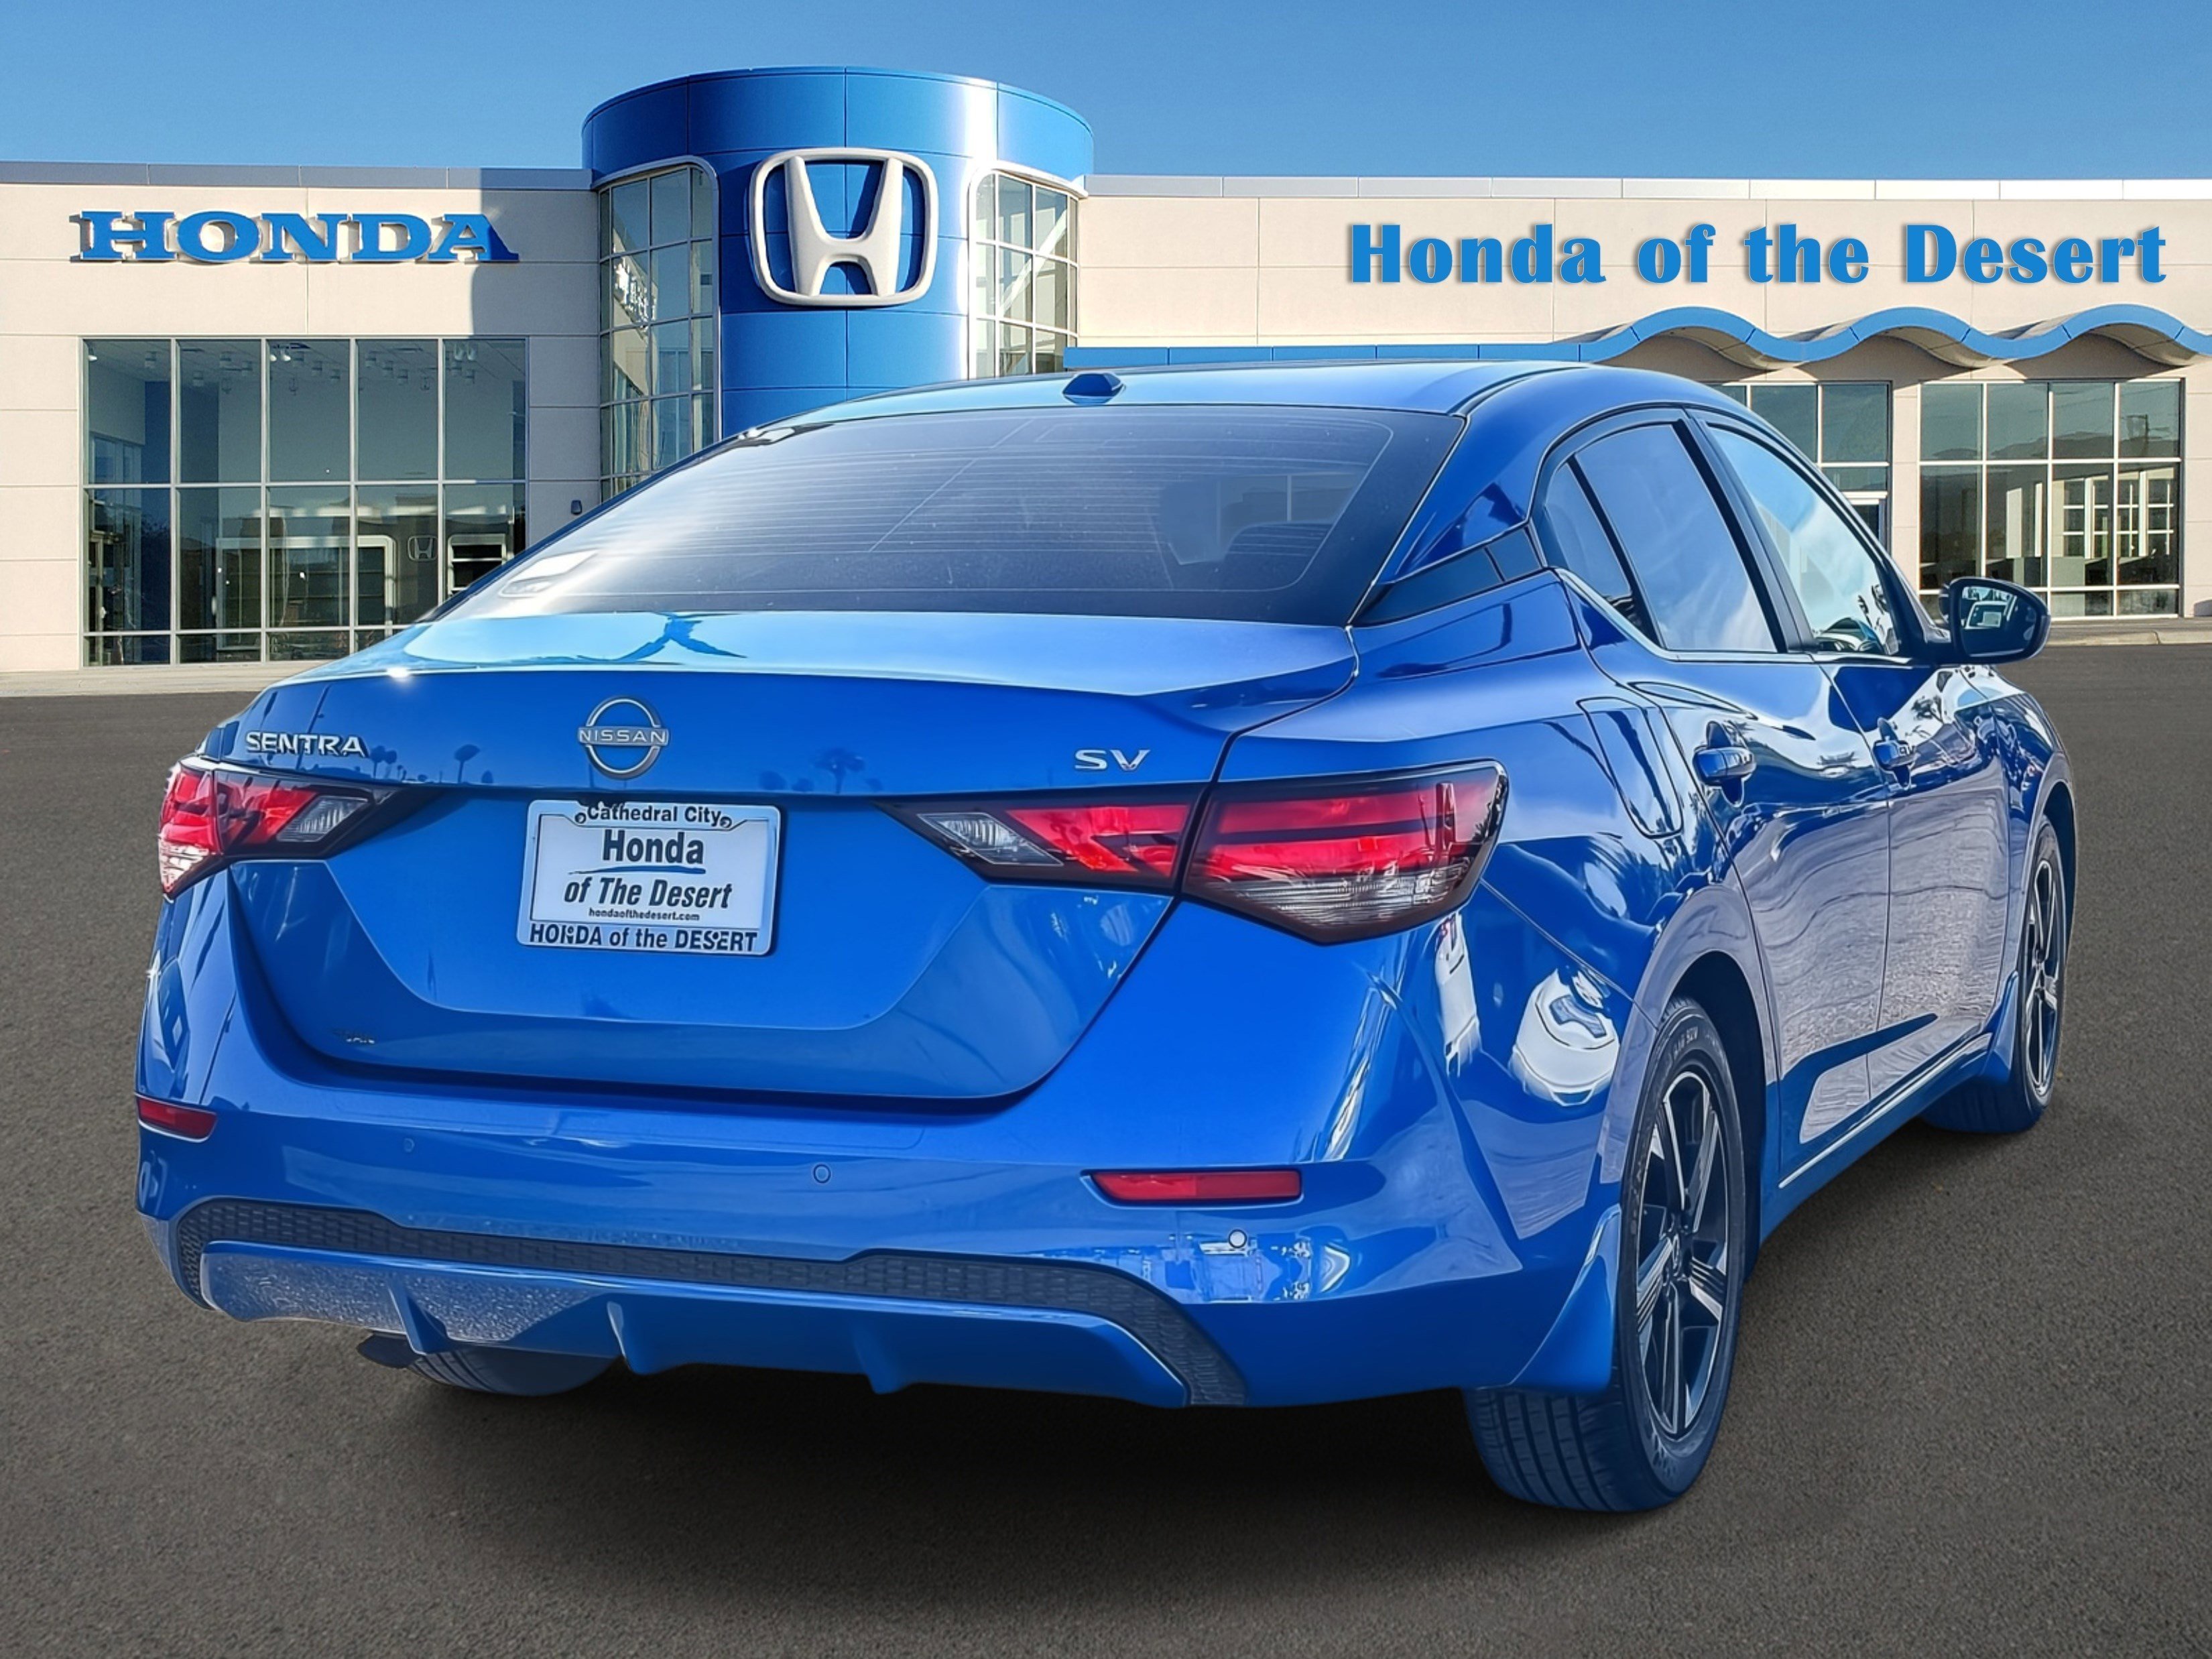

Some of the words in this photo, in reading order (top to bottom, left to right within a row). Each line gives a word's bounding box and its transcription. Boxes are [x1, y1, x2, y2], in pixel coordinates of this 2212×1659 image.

[80, 210, 519, 262] HONDA
[1352, 224, 1607, 283] Honda
[1638, 223, 1716, 283] of
[1743, 223, 1869, 283] the
[1906, 225, 2166, 283] Desert
[246, 731, 367, 757] SENTRA
[579, 729, 666, 743] NISSAN
[1074, 749, 1151, 771] SV
[587, 804, 677, 822] Cathedral
[684, 807, 722, 826] City
[603, 829, 704, 864] Honda
[564, 877, 591, 903] of
[600, 877, 642, 906] The
[649, 879, 733, 909] Desert
[589, 908, 700, 922] hondaofthedesert.com
[530, 923, 602, 946] HONDA
[609, 928, 632, 947] of
[635, 928, 667, 948] the
[674, 930, 758, 952] DESERT
